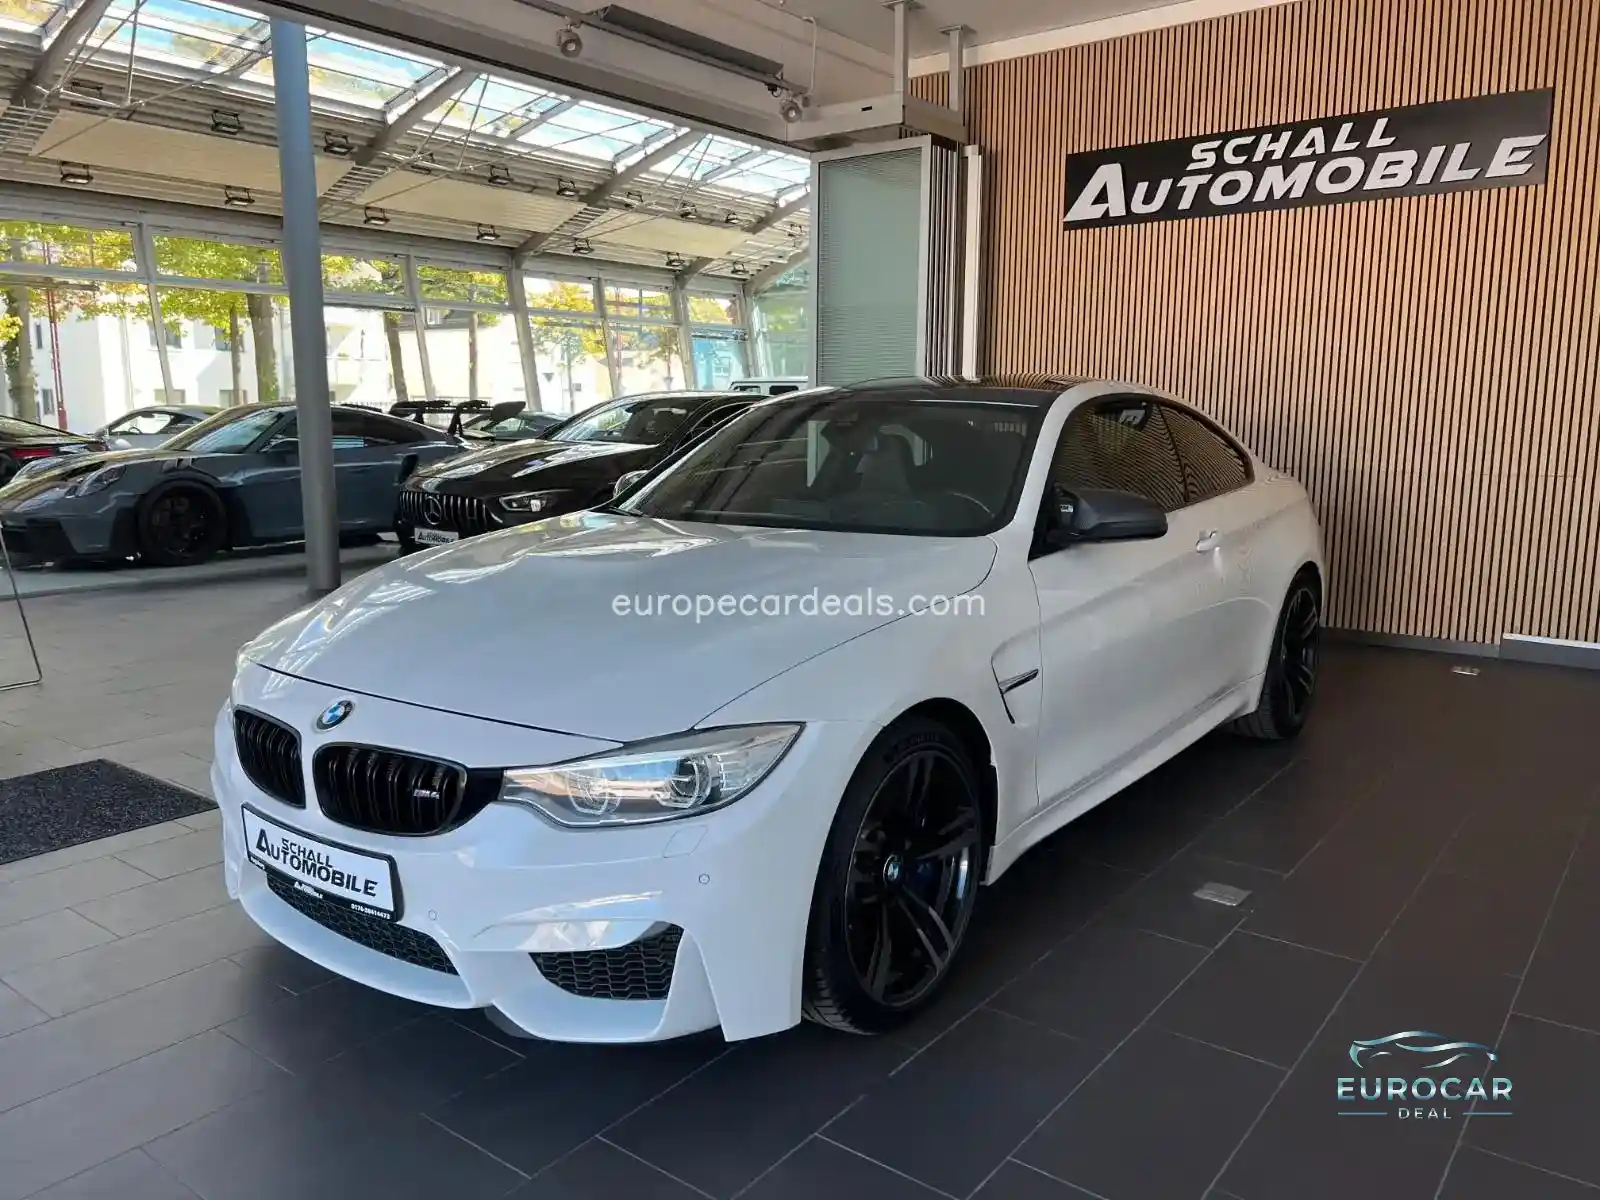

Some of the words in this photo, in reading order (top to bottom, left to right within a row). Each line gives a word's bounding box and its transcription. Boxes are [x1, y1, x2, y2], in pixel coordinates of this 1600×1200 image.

[1186, 117, 1398, 171] SCHALL
[1062, 133, 1548, 222] AUTOMOBILE
[255, 828, 379, 897] AUTOMOBILE
[281, 837, 333, 868] SCHALL
